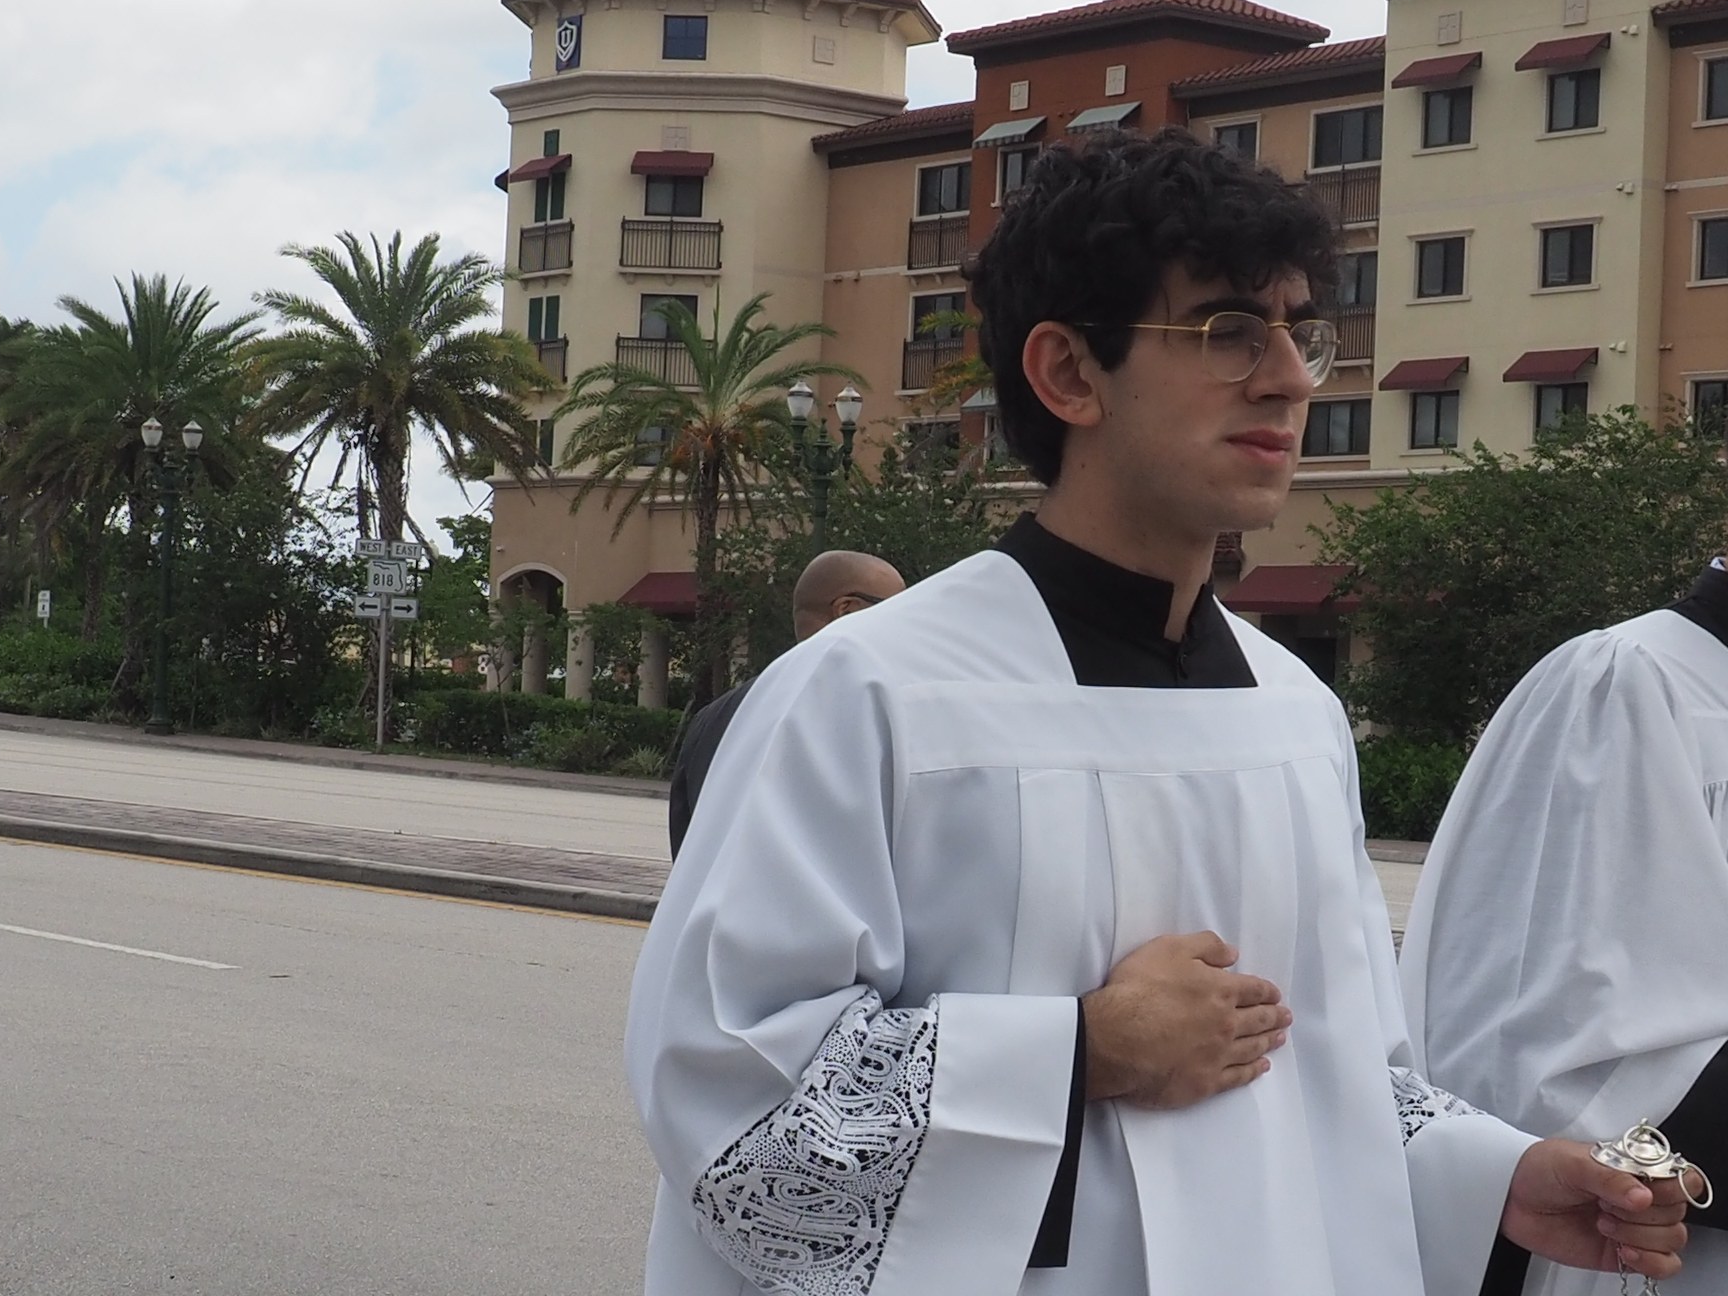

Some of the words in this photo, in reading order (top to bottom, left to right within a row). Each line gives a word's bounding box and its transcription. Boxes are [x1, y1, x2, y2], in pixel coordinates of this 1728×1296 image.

[359, 542, 382, 553] WEST
[395, 544, 418, 556] EAST
[373, 574, 394, 587] 818
